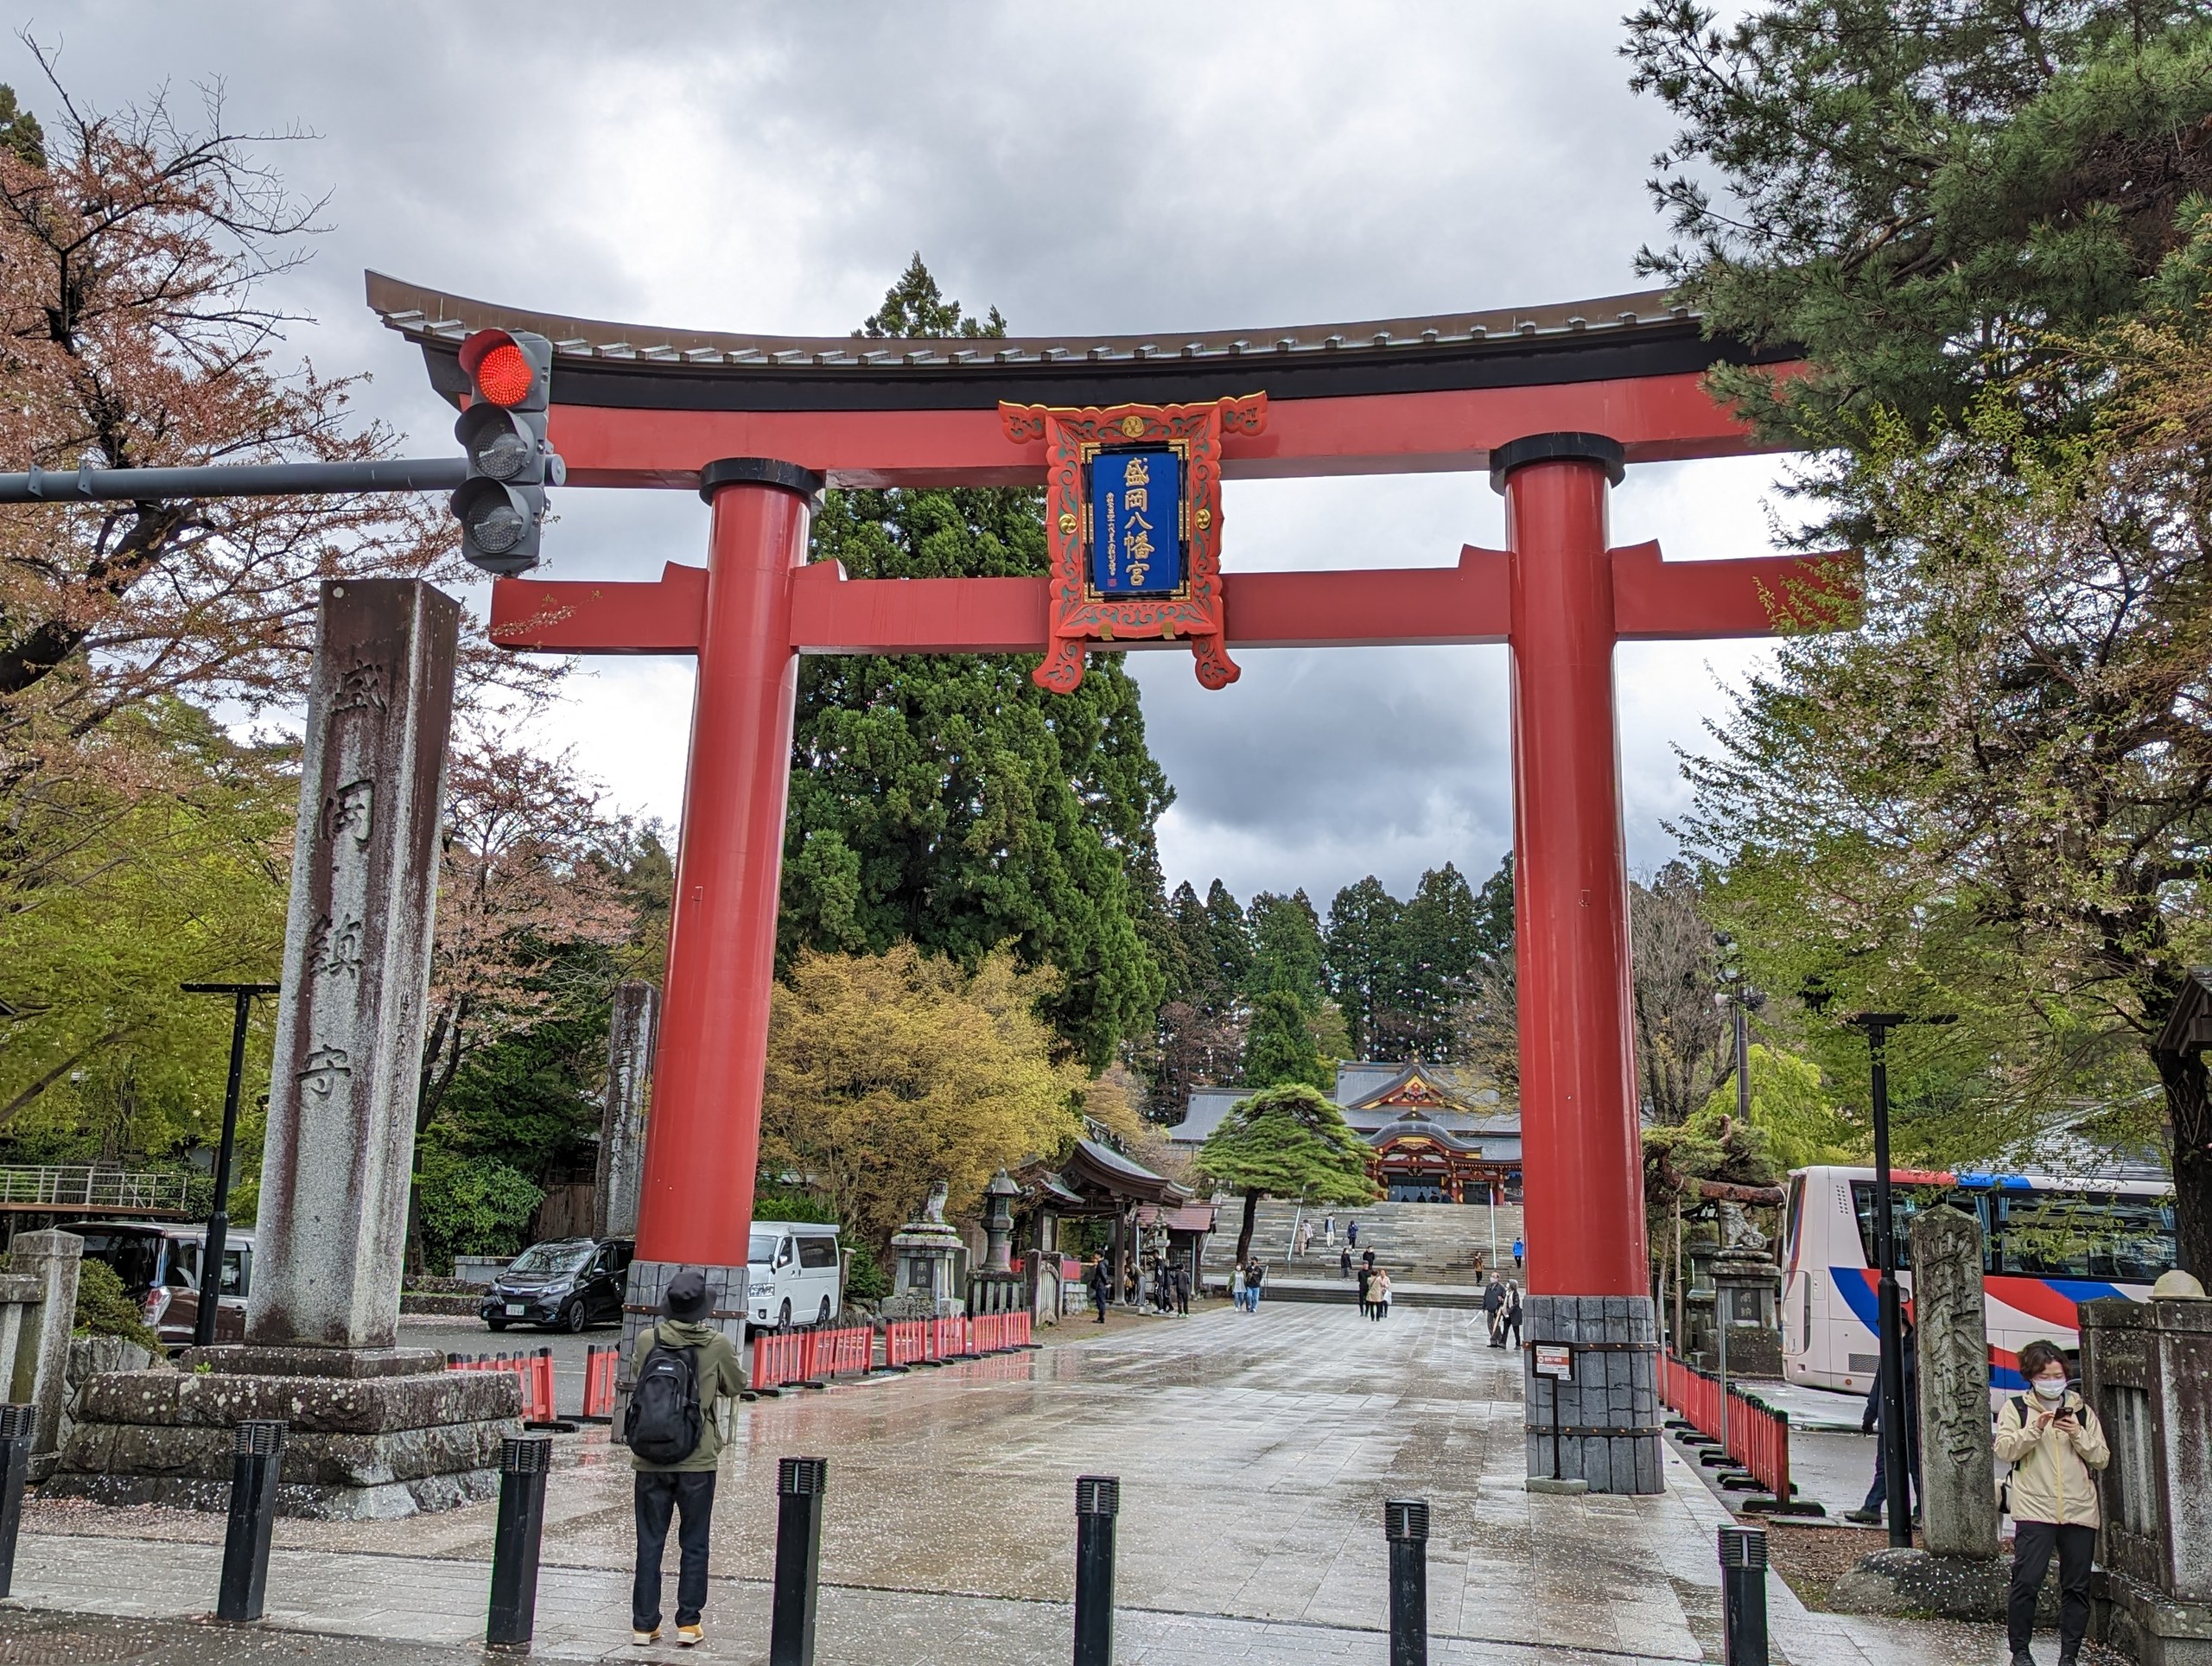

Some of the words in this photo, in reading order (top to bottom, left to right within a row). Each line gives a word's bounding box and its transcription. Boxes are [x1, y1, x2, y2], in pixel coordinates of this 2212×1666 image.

[1123, 456, 1155, 588] 盛岡八幡宮
[295, 658, 388, 1102] 盛岡鎮守
